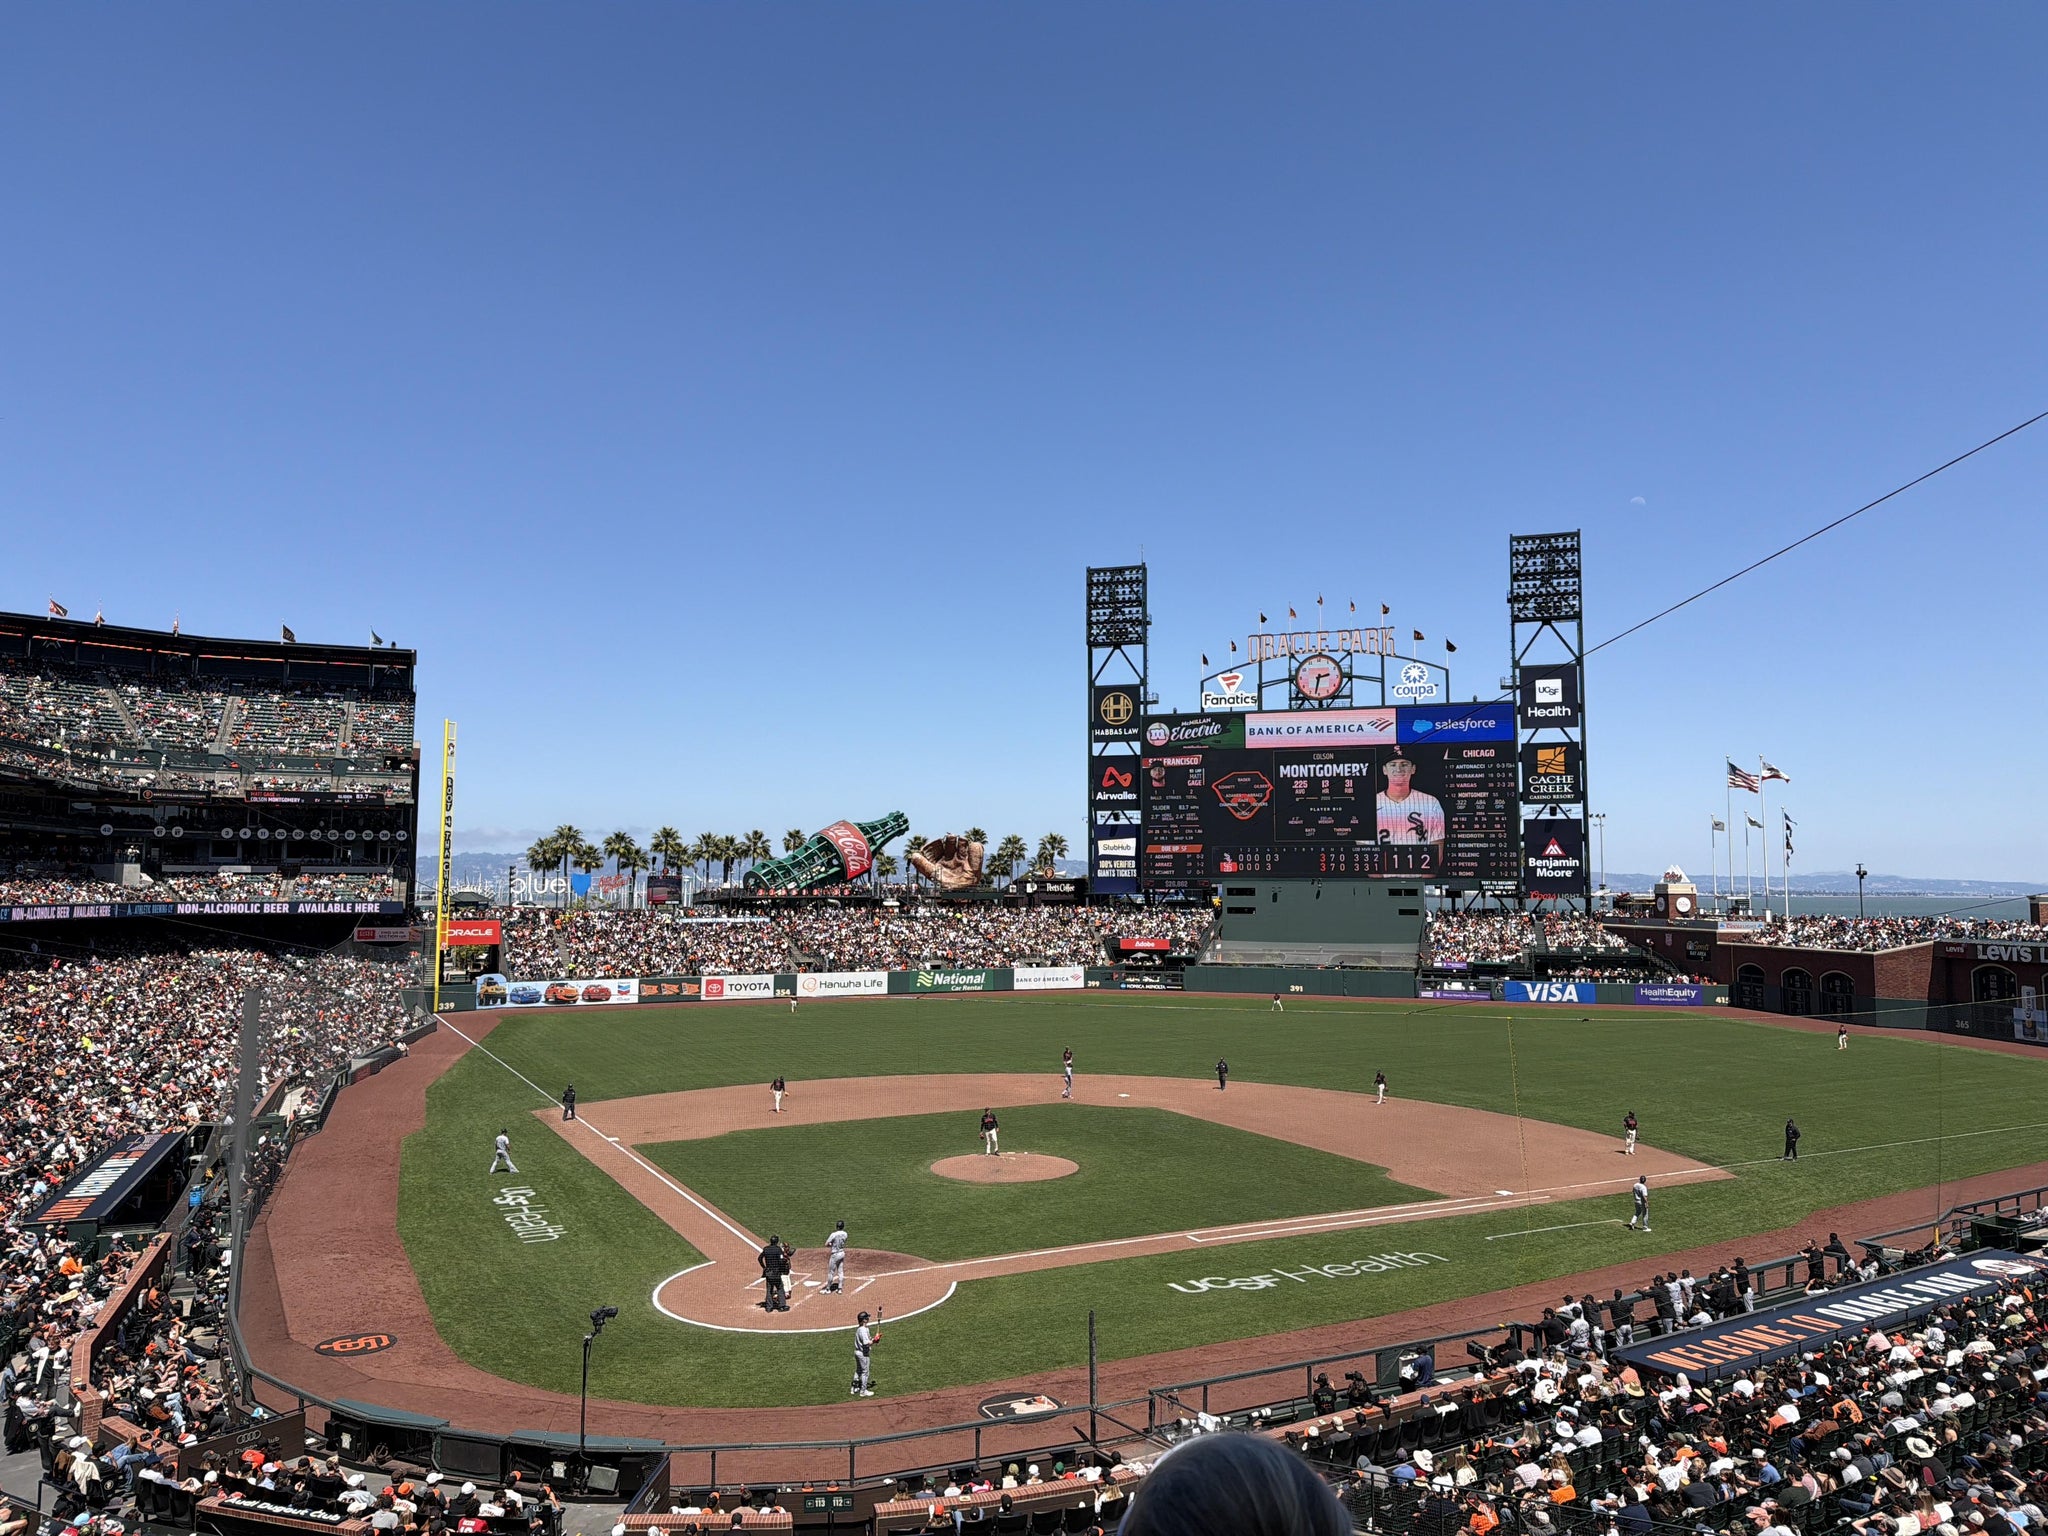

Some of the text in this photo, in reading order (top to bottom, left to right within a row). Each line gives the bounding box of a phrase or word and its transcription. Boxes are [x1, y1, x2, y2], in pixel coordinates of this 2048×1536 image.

[1248, 627, 1396, 664] ORACLE PARK
[1395, 684, 1434, 697] coupa
[1537, 686, 1560, 696] UCSF
[1204, 694, 1257, 705] Fanatics
[1527, 705, 1571, 718] Health
[1248, 724, 1365, 736] BANK OF AMERICA
[1435, 718, 1496, 732] salesforce
[1170, 722, 1222, 741] Electric
[1313, 752, 1334, 760] COLSON
[1463, 749, 1495, 758] CHICAGO
[1163, 758, 1198, 766] FRANCISCO
[1280, 763, 1369, 778] MONTGOMERY
[1292, 779, 1353, 789] .225 13 31
[1529, 775, 1575, 784] CACHE
[1530, 784, 1573, 793] CREEK
[1096, 791, 1138, 800] Airwallex
[1273, 854, 1279, 862] 3
[1320, 853, 1326, 862] 3
[1330, 854, 1335, 862] 7
[1340, 854, 1345, 862] 0
[1353, 854, 1360, 862] 3
[1363, 854, 1369, 862] 3
[1373, 854, 1379, 862] 2
[1392, 854, 1431, 869] 1 1 2
[1099, 860, 1135, 869] 100% VERIFIED
[1238, 863, 1370, 872] 0 0 0 3 3 7 0 3 3
[1529, 858, 1580, 869] Benjamin
[1097, 869, 1137, 877] GIANTS TICKETS
[1536, 868, 1572, 877] Moore
[1060, 883, 1075, 892] Coffee
[1530, 890, 1557, 900] Coors
[11, 905, 111, 921] NON-ALCOHOLIC BEER AVAILABLE HERE
[177, 902, 380, 915] NON-ALCOHOLIC BEER AVAILABLE HERE
[447, 929, 493, 937] ORACLE
[933, 972, 986, 985] National
[728, 982, 771, 992] TOYOTA
[819, 979, 883, 990] Hanwha Life
[775, 988, 790, 996] 354
[1520, 983, 1579, 1002] VISA
[1640, 988, 1697, 998] HealthEquity
[438, 1002, 455, 1011] 339
[1955, 1019, 1970, 1029] 365
[499, 1204, 569, 1244] Health
[1166, 1251, 1450, 1293] UCSF Health
[1646, 1272, 1993, 1371] WELCOME TO ORACLE PARK
[815, 1499, 826, 1507] 113
[832, 1498, 843, 1507] 112
[224, 1497, 341, 1521] Audi Dugout Club
